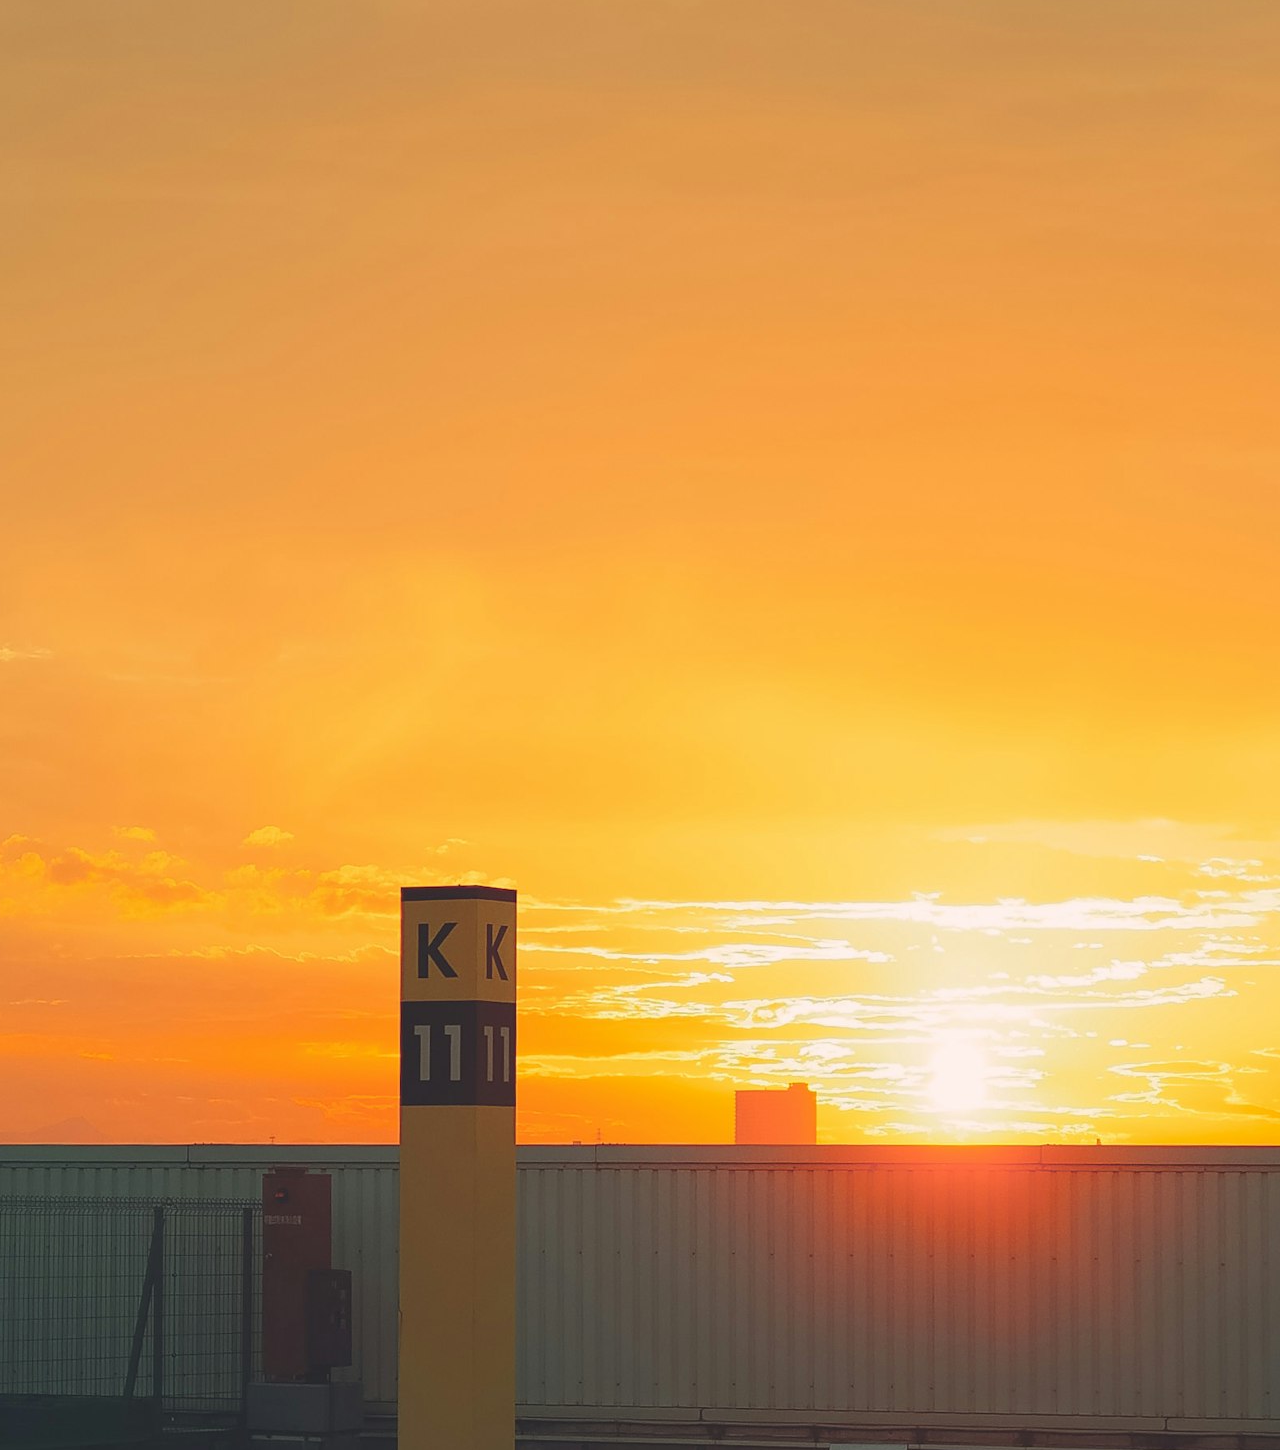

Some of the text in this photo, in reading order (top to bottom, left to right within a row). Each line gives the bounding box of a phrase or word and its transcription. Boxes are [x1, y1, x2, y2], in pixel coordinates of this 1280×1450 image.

[418, 922, 458, 978] K
[486, 923, 510, 980] K
[414, 1024, 461, 1081] 11
[483, 1025, 510, 1082] 11
